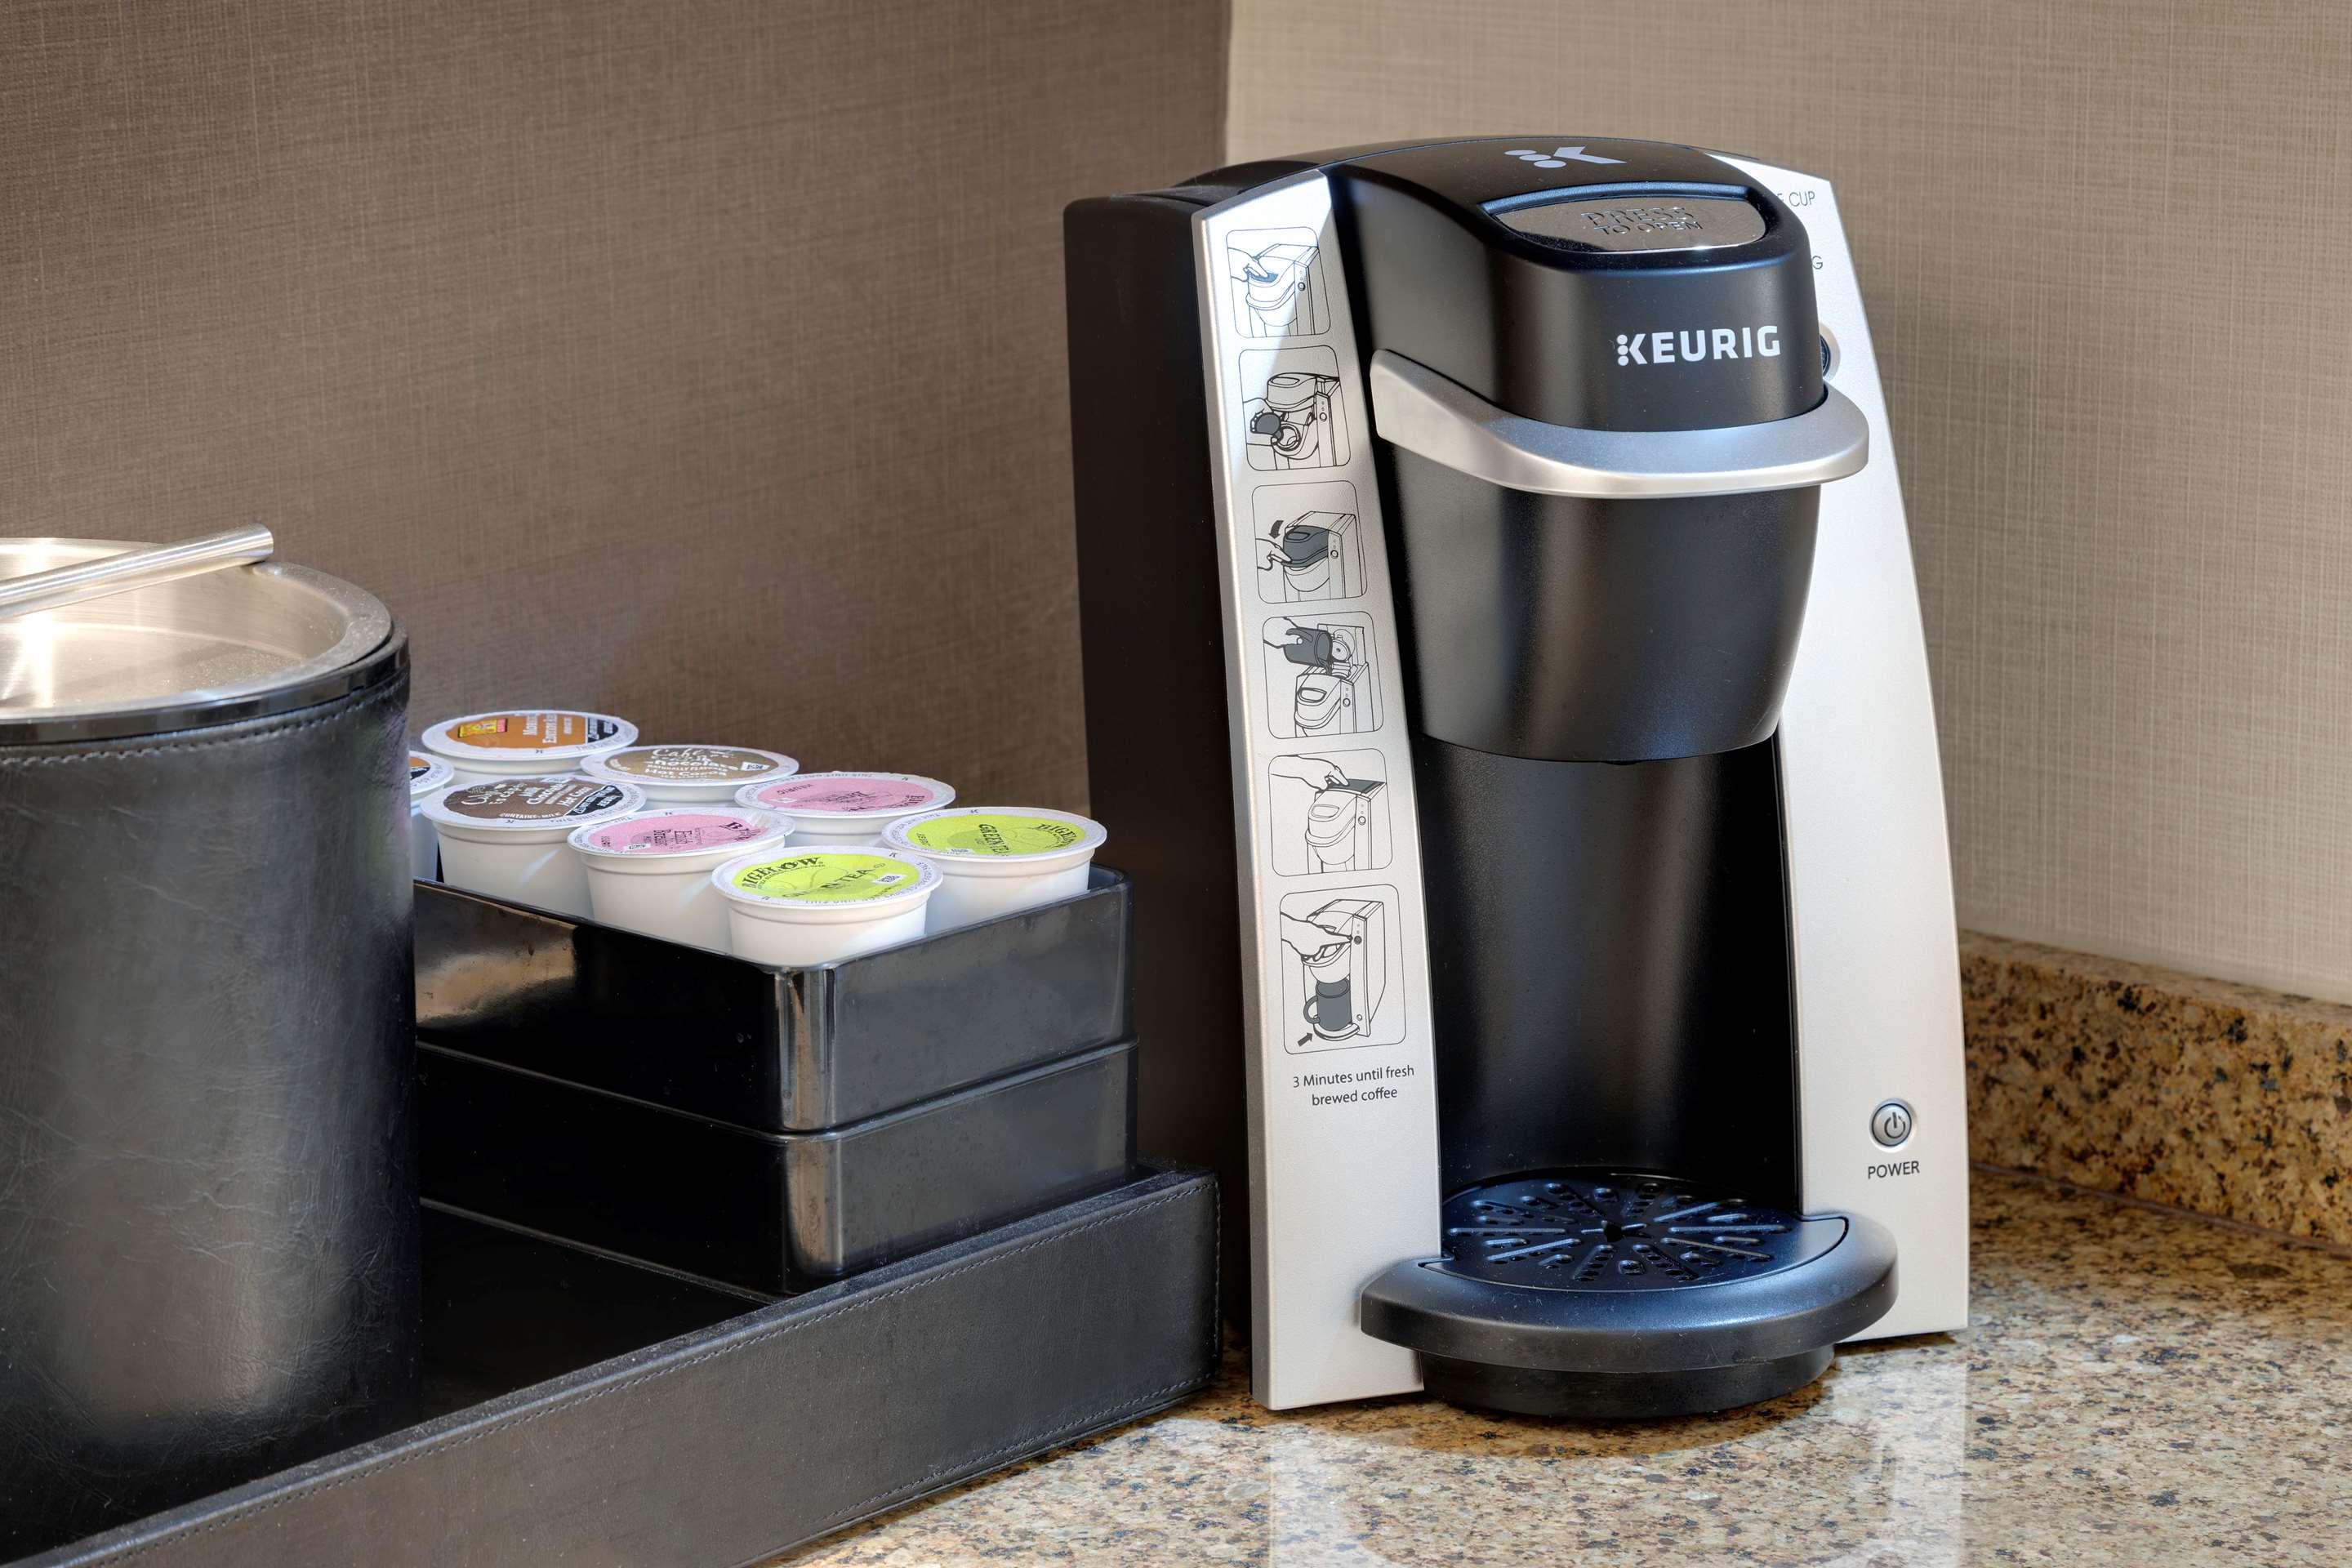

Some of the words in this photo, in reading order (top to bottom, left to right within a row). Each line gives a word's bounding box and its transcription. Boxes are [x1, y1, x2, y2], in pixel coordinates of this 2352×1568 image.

[1788, 190, 1815, 207] CUP
[1581, 207, 1695, 226] PRESS
[1593, 224, 1632, 235] TO
[1637, 220, 1704, 234] OPEN
[1616, 325, 1781, 367] KEURIG
[978, 823, 1004, 845] GREEN
[840, 866, 875, 882] TEA
[1293, 1076, 1300, 1089] 3
[1303, 1072, 1353, 1087] Minutes
[1356, 1067, 1383, 1082] until
[1385, 1064, 1414, 1079] fresh
[1312, 1089, 1358, 1107] brewed
[1361, 1086, 1398, 1102] coffee
[1867, 1160, 1921, 1180] POWER
